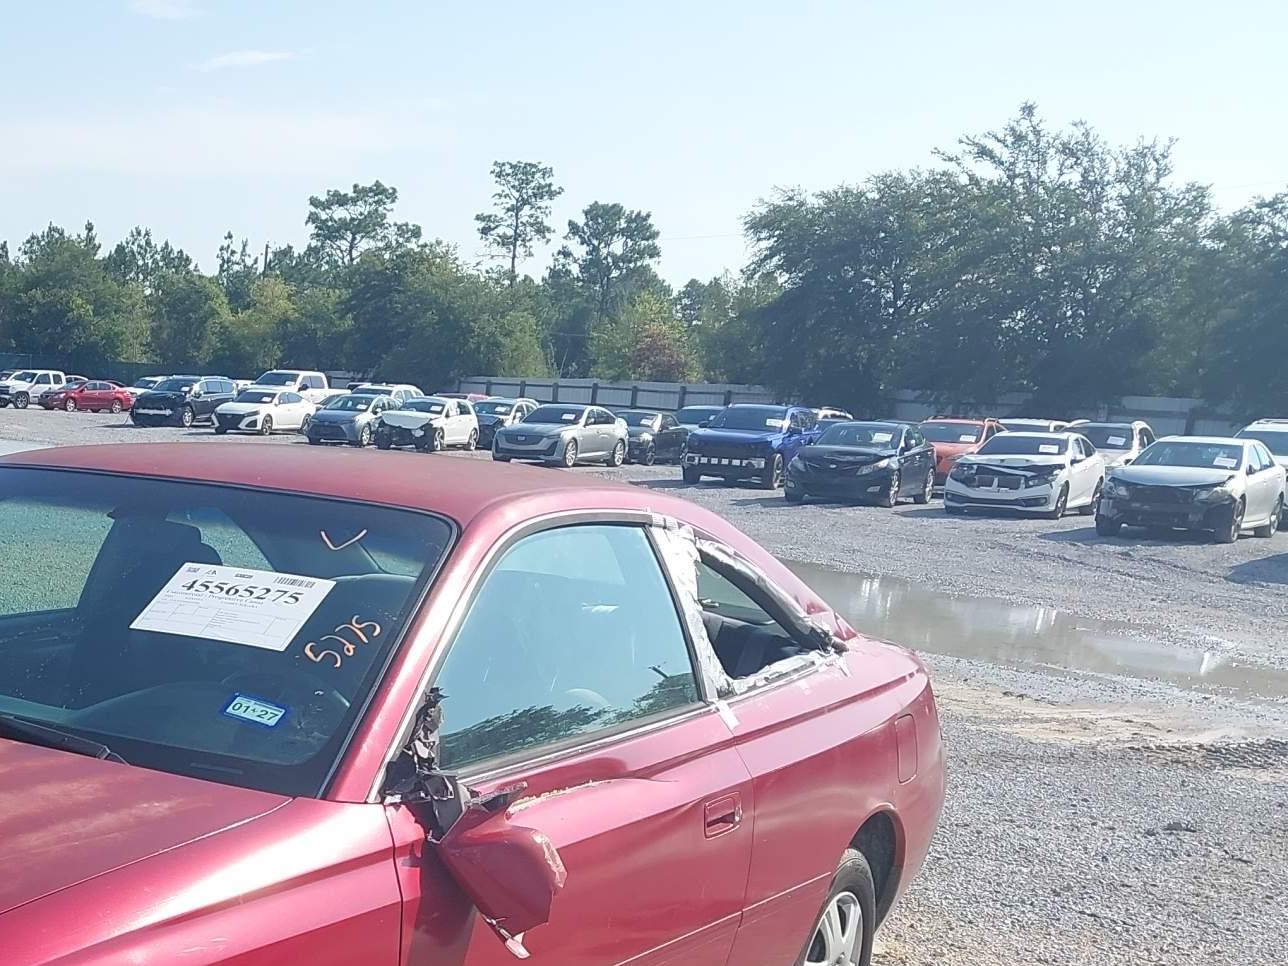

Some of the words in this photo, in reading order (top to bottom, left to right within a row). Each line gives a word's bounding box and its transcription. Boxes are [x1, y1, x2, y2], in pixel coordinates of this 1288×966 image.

[181, 579, 304, 605] 45565275
[304, 614, 381, 667] 5275
[232, 702, 250, 713] 01
[257, 709, 278, 720] 27
